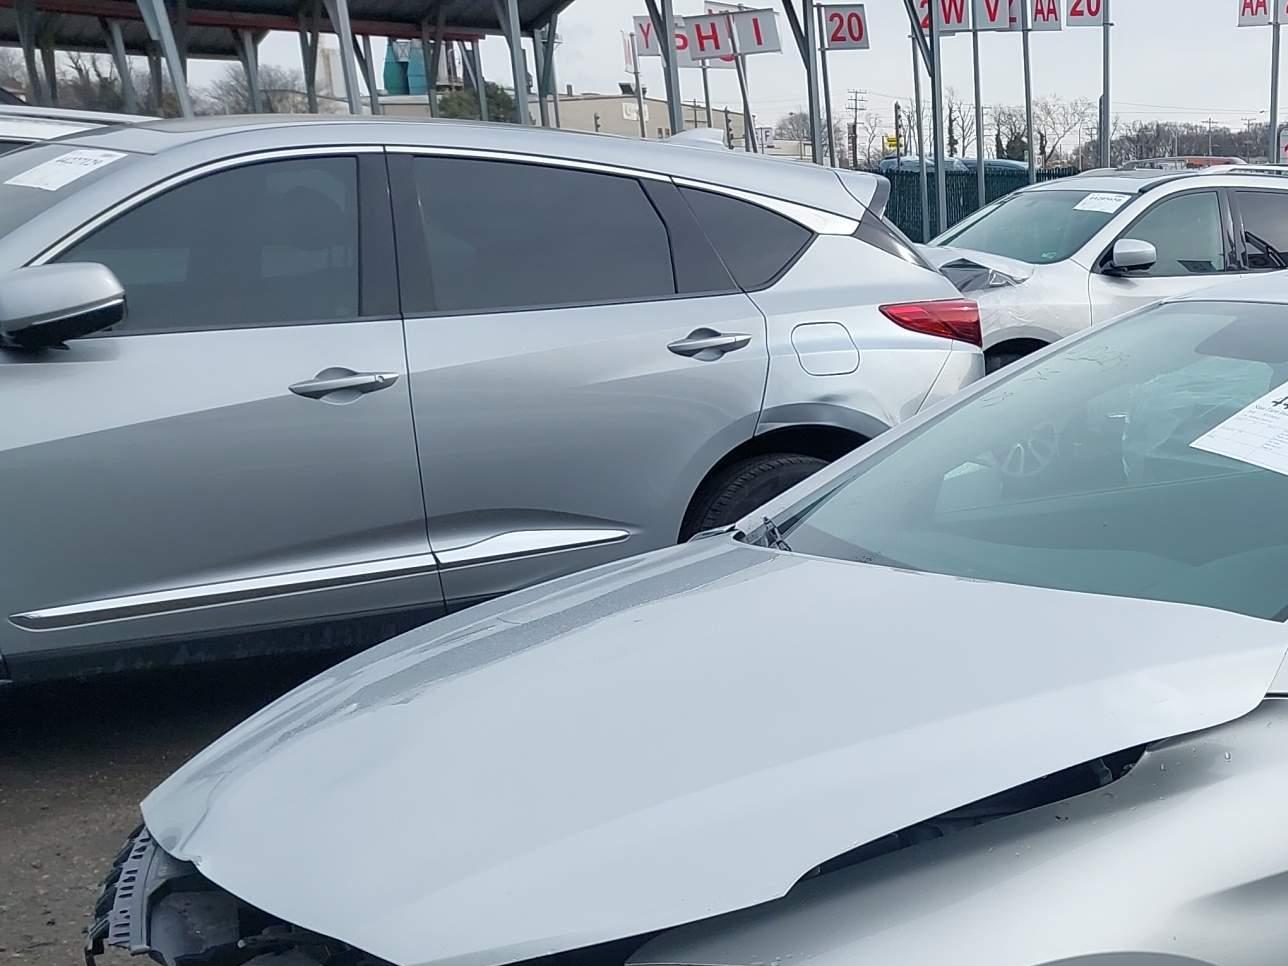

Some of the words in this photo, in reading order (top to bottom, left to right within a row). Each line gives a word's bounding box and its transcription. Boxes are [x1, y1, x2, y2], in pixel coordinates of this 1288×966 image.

[940, 0, 966, 24] W
[983, 0, 1000, 22] V
[1033, 0, 1058, 21] AA
[638, 22, 651, 49] Y
[694, 21, 721, 51] H
[828, 12, 864, 42] 20
